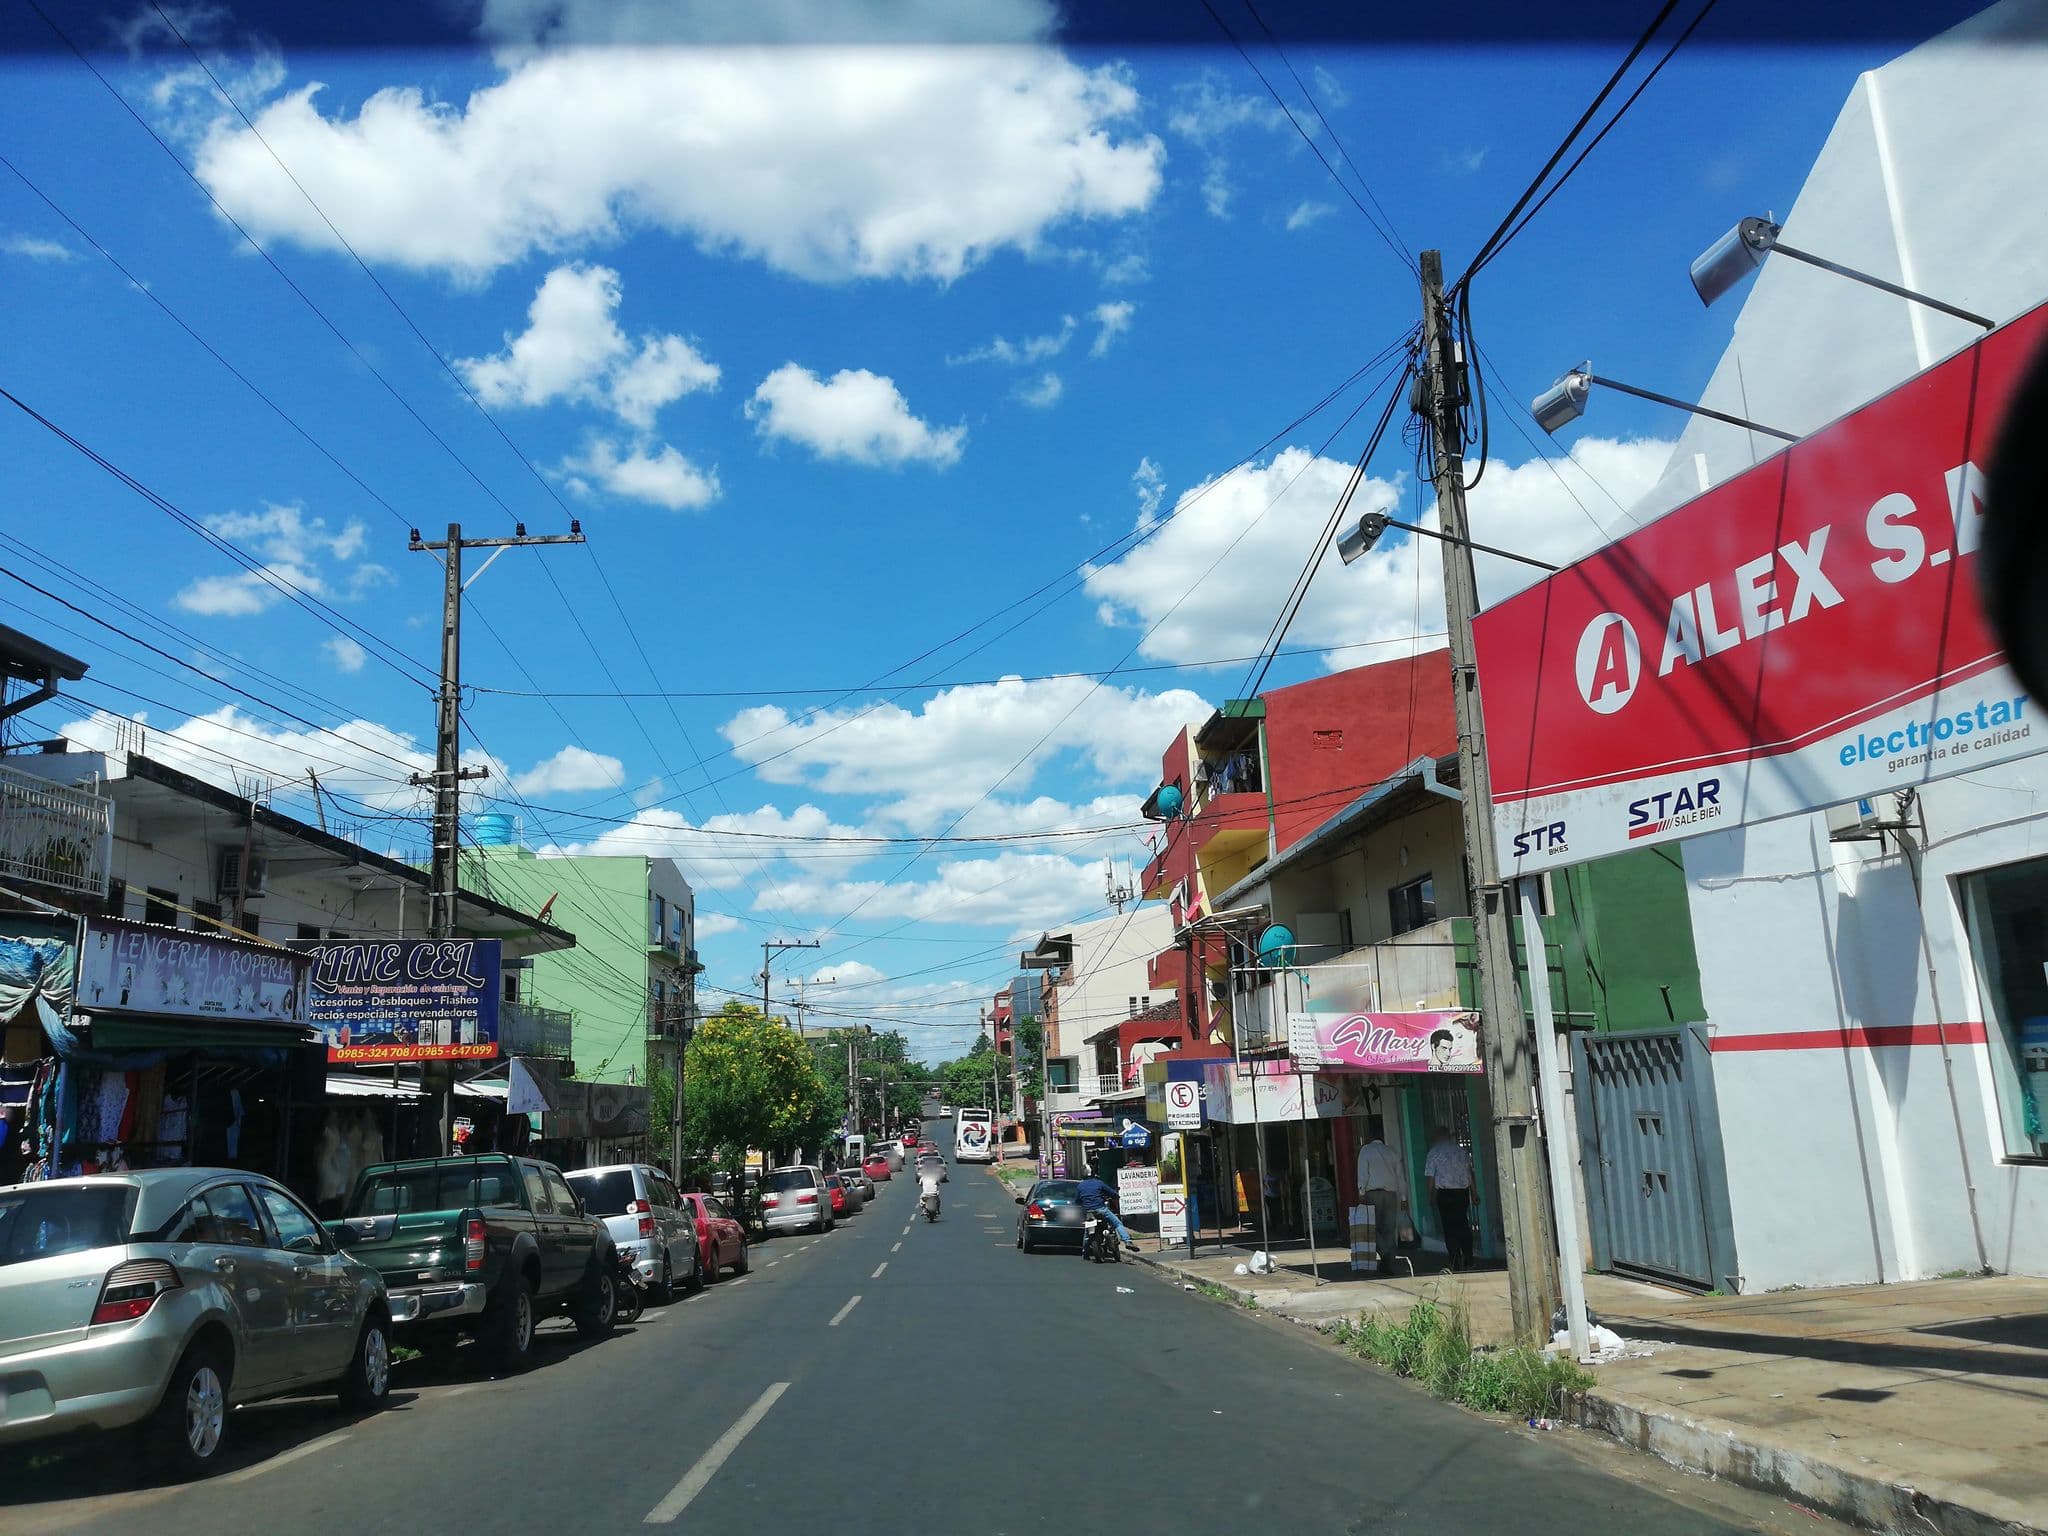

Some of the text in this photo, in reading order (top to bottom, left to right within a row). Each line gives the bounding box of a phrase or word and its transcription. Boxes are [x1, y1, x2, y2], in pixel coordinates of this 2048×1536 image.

[1658, 524, 1845, 678] ALEX
[1839, 695, 2030, 767] electrostar
[1951, 742, 1969, 756] de
[1974, 724, 2030, 751] calidad
[1628, 778, 1721, 828] STAR
[1674, 805, 1722, 828] SALE BIEN
[1513, 820, 1566, 858] STR
[1549, 844, 1569, 856] BIKES
[117, 929, 293, 981] LENCERIA Y ROPERIA
[310, 942, 486, 994] LINE CEL
[337, 984, 364, 994] Venta
[371, 996, 432, 1008] Desbloqueo
[440, 995, 479, 1005] Flasheo
[346, 1010, 399, 1021] especiales
[409, 1009, 478, 1018] revendedores
[336, 1047, 388, 1059] 0985-324
[390, 1047, 410, 1057] 708
[418, 1046, 444, 1056] 0985
[451, 1046, 472, 1056] 647
[473, 1045, 493, 1055] 099
[1332, 1015, 1427, 1057] Mary
